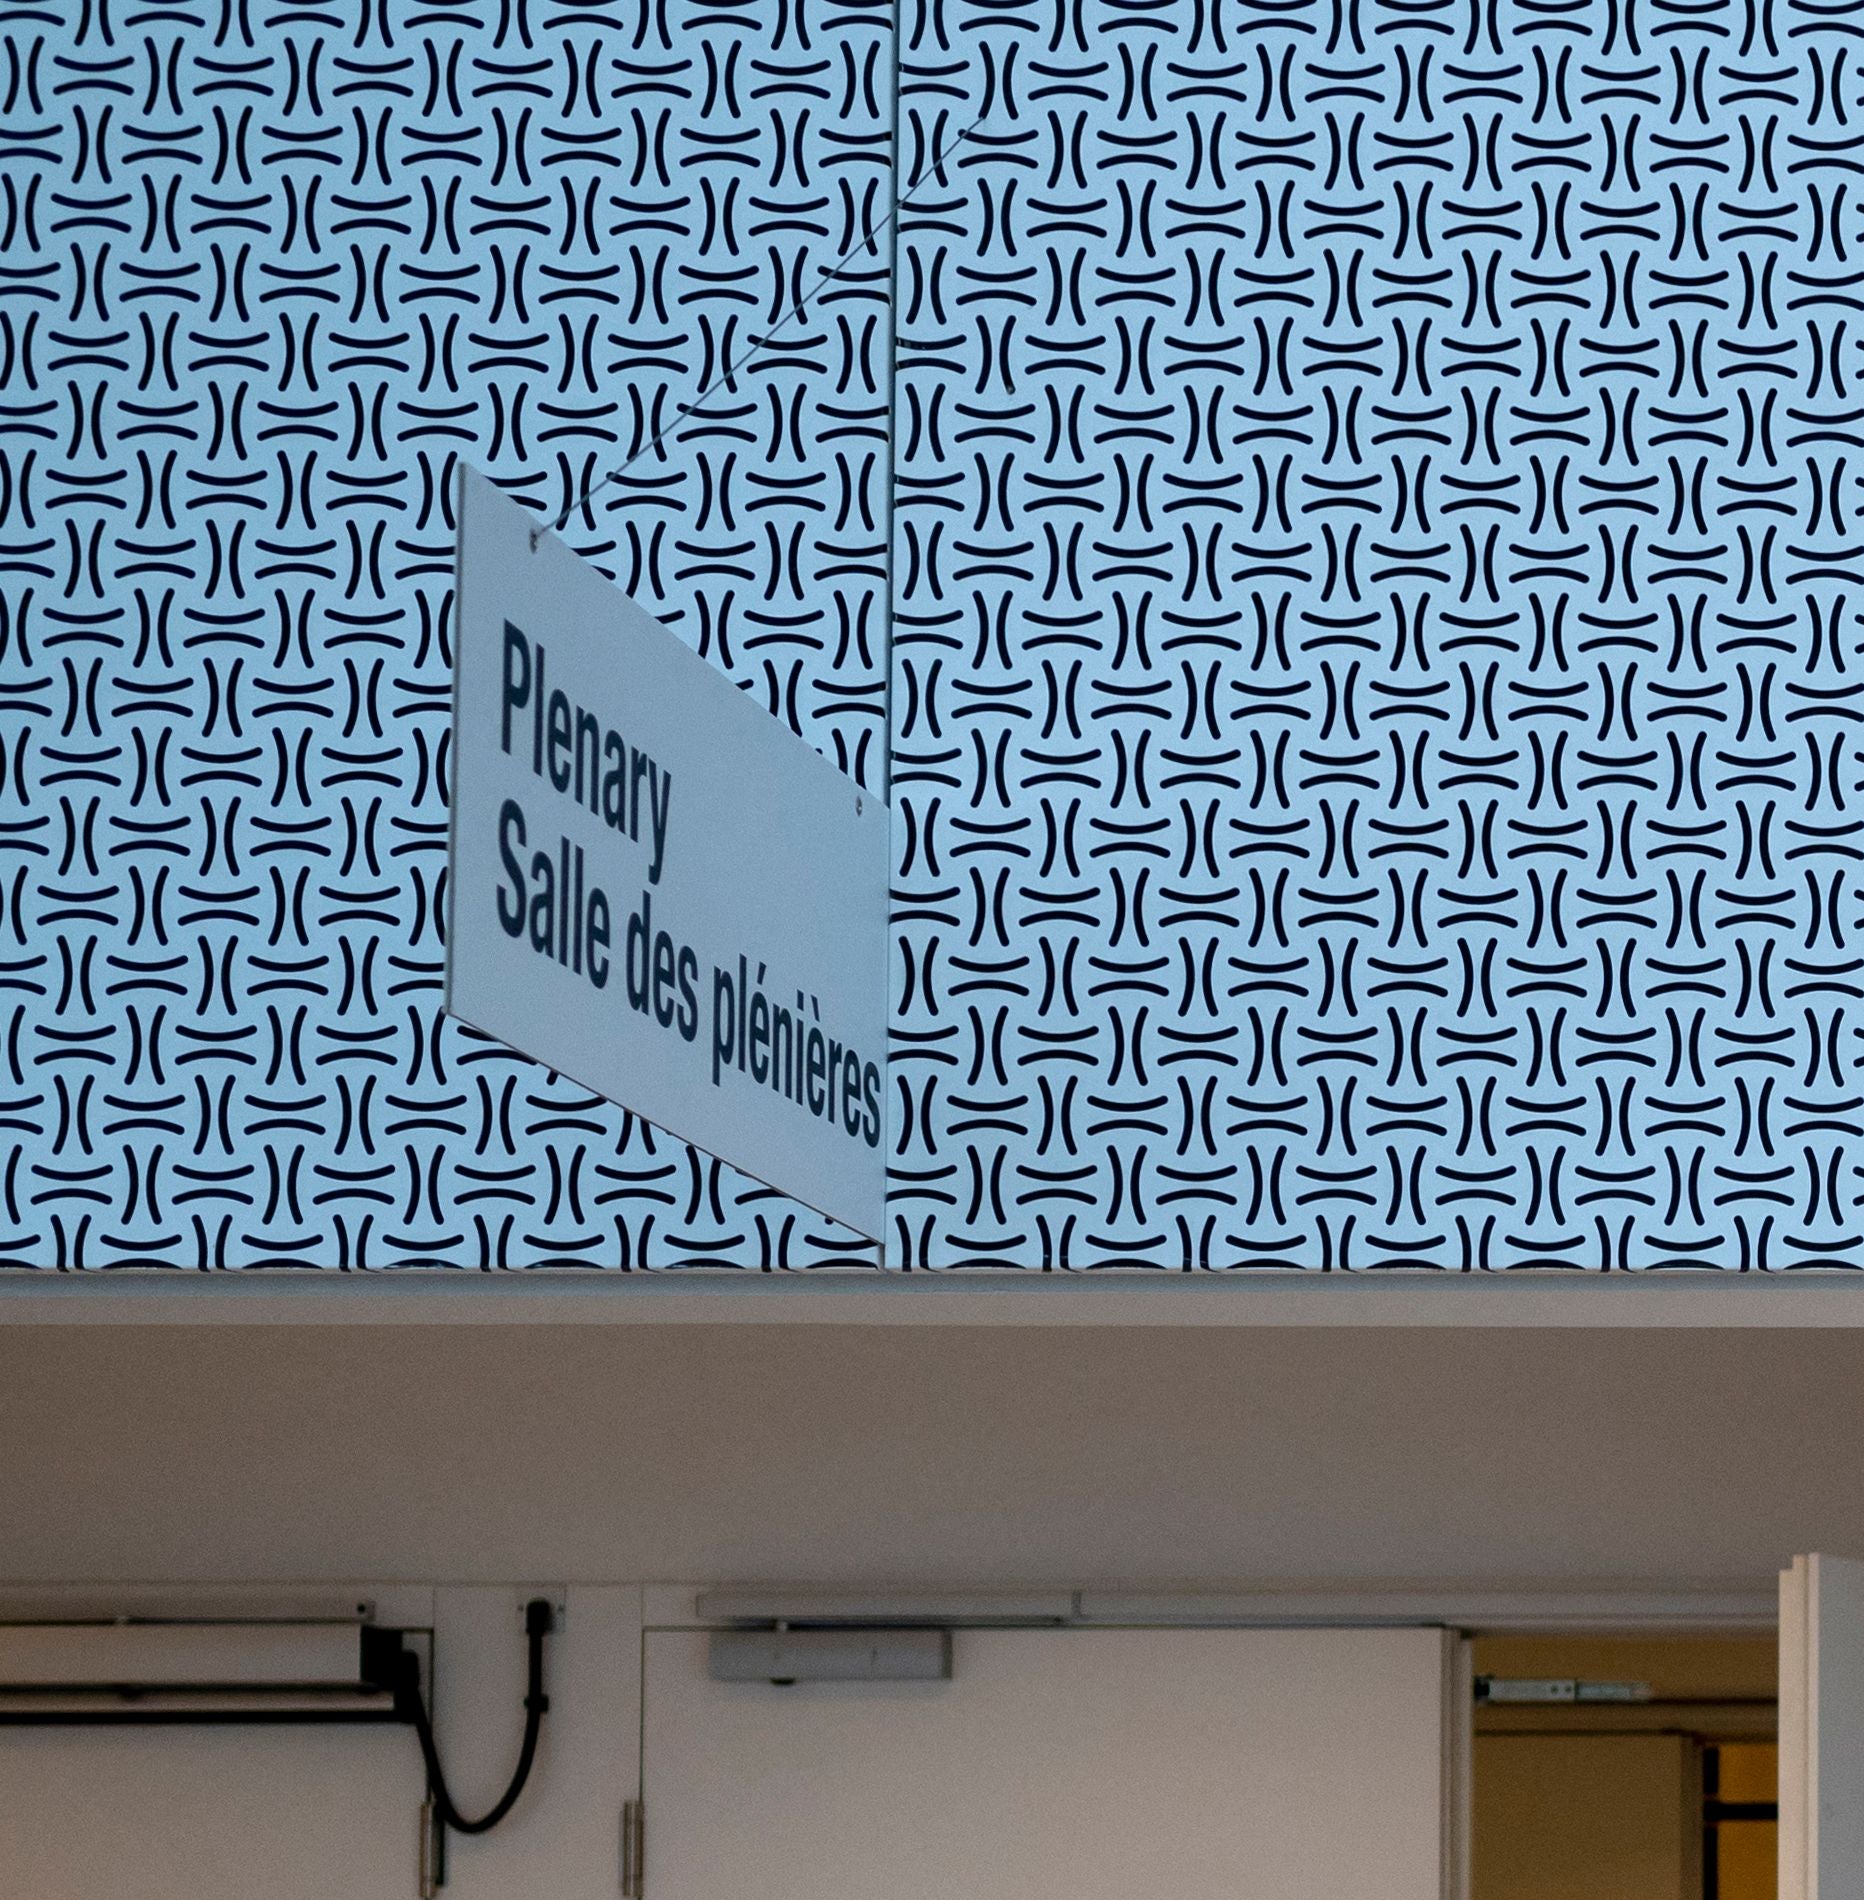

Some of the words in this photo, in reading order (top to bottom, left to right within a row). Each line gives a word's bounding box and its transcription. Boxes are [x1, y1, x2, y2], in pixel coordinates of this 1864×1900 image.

[500, 618, 673, 886] Plenary
[496, 797, 612, 991] Salle
[626, 889, 700, 1044] des
[711, 953, 883, 1150] plénières
